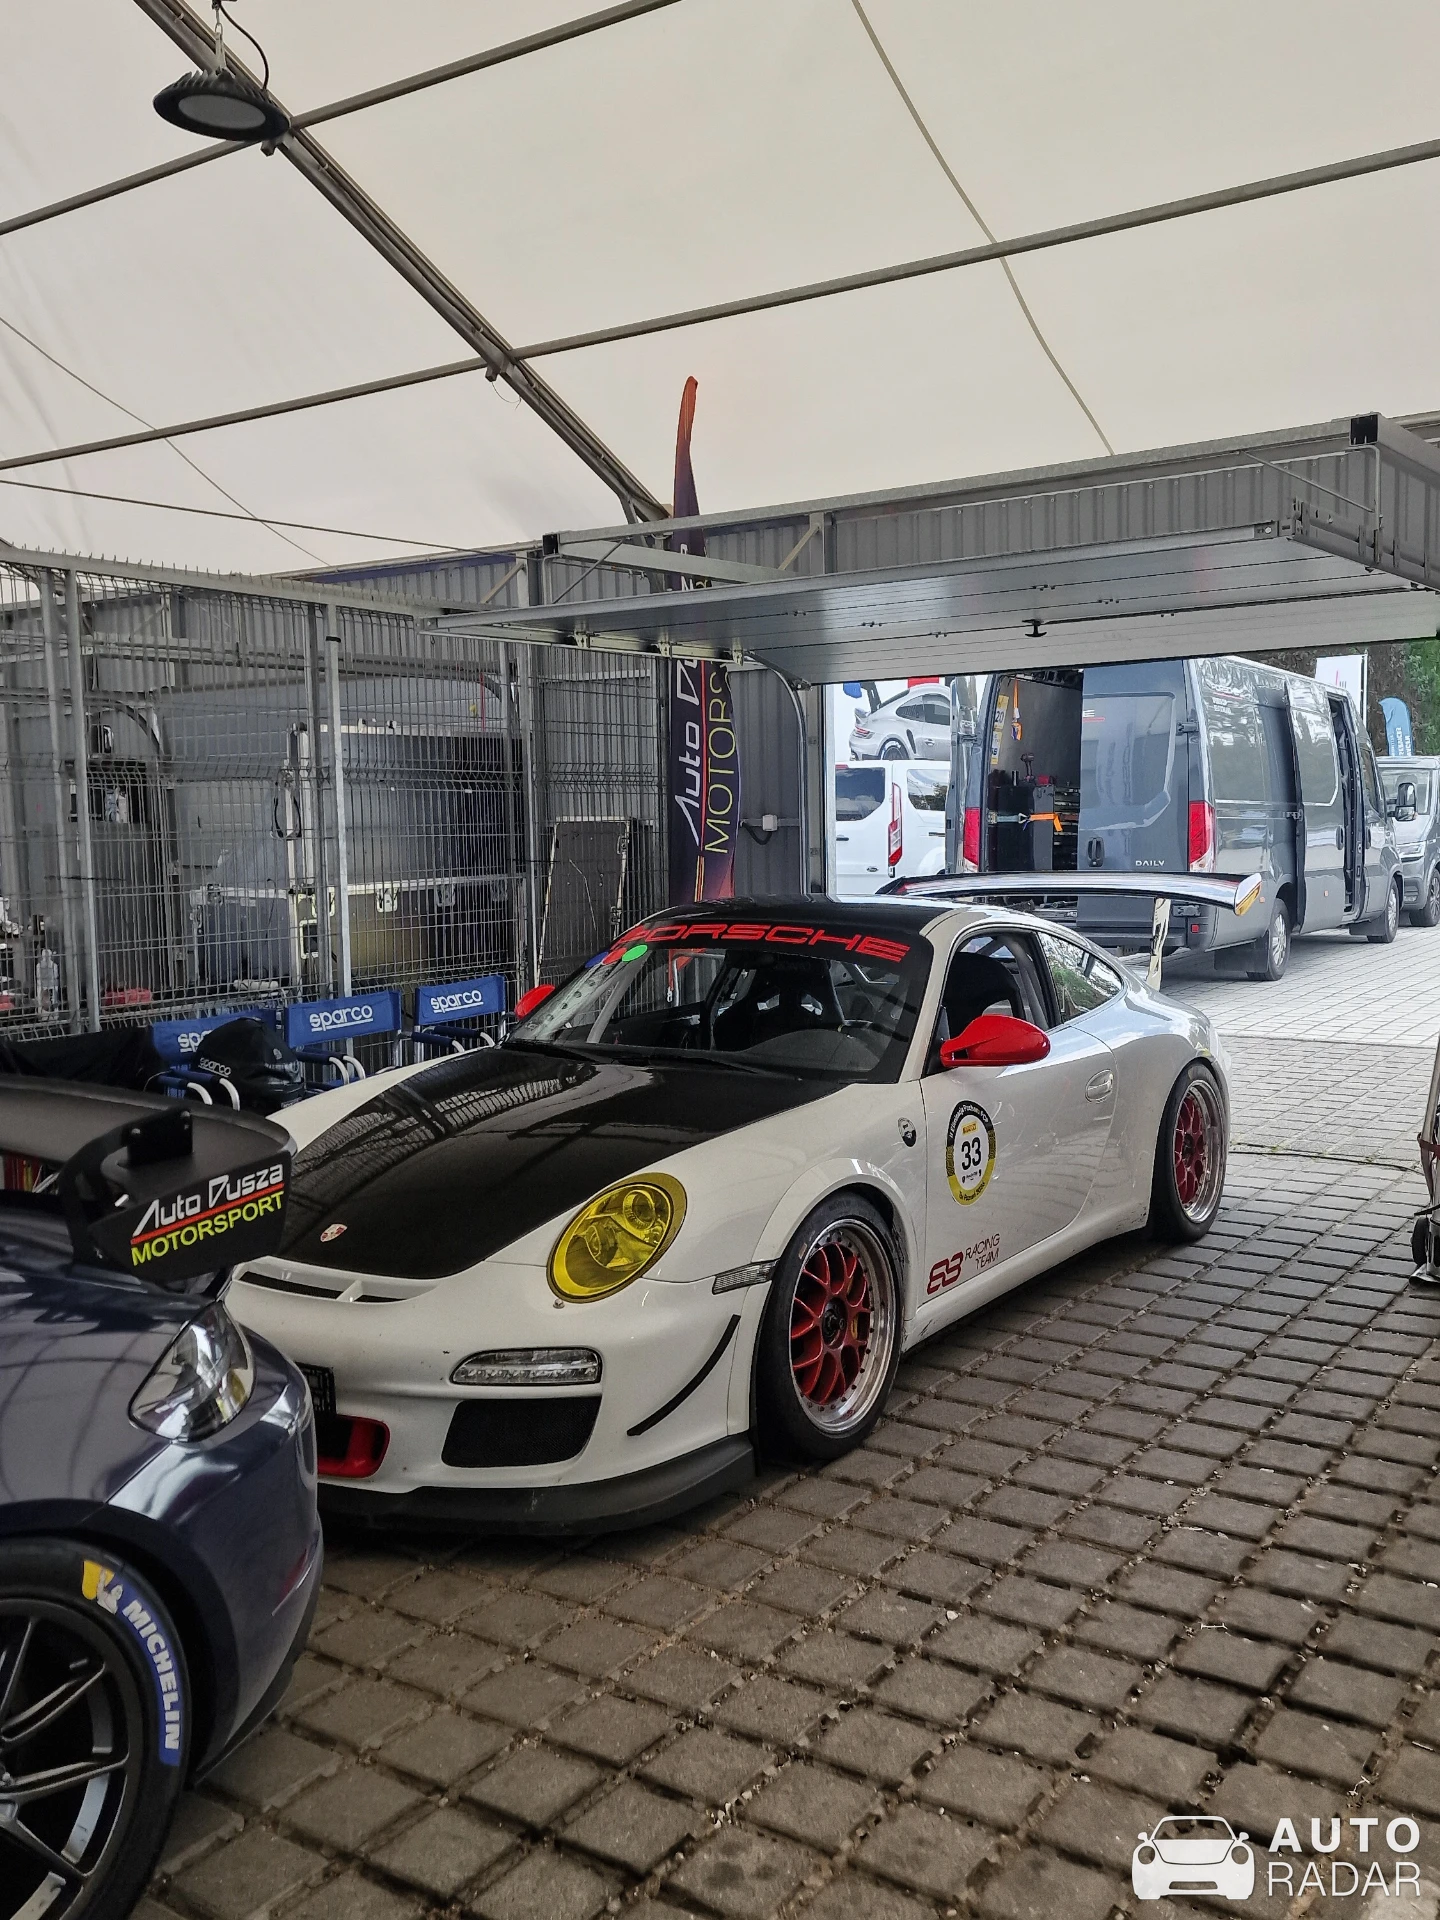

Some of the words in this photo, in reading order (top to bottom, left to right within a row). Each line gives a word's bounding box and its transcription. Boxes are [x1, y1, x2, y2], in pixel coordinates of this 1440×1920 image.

[674, 721, 701, 847] Auto
[609, 924, 911, 963] PORSCHE
[309, 1004, 373, 1032] sparco
[430, 989, 483, 1014] sparco
[198, 1056, 231, 1077] sparco
[961, 1137, 981, 1171] 33
[132, 1194, 202, 1238] Auto
[208, 1163, 284, 1209] Dusza
[130, 1191, 285, 1267] MOTORSPORT
[965, 1233, 1001, 1261] RACING
[975, 1248, 999, 1270] TEAM
[122, 1599, 182, 1750] MICHELIN
